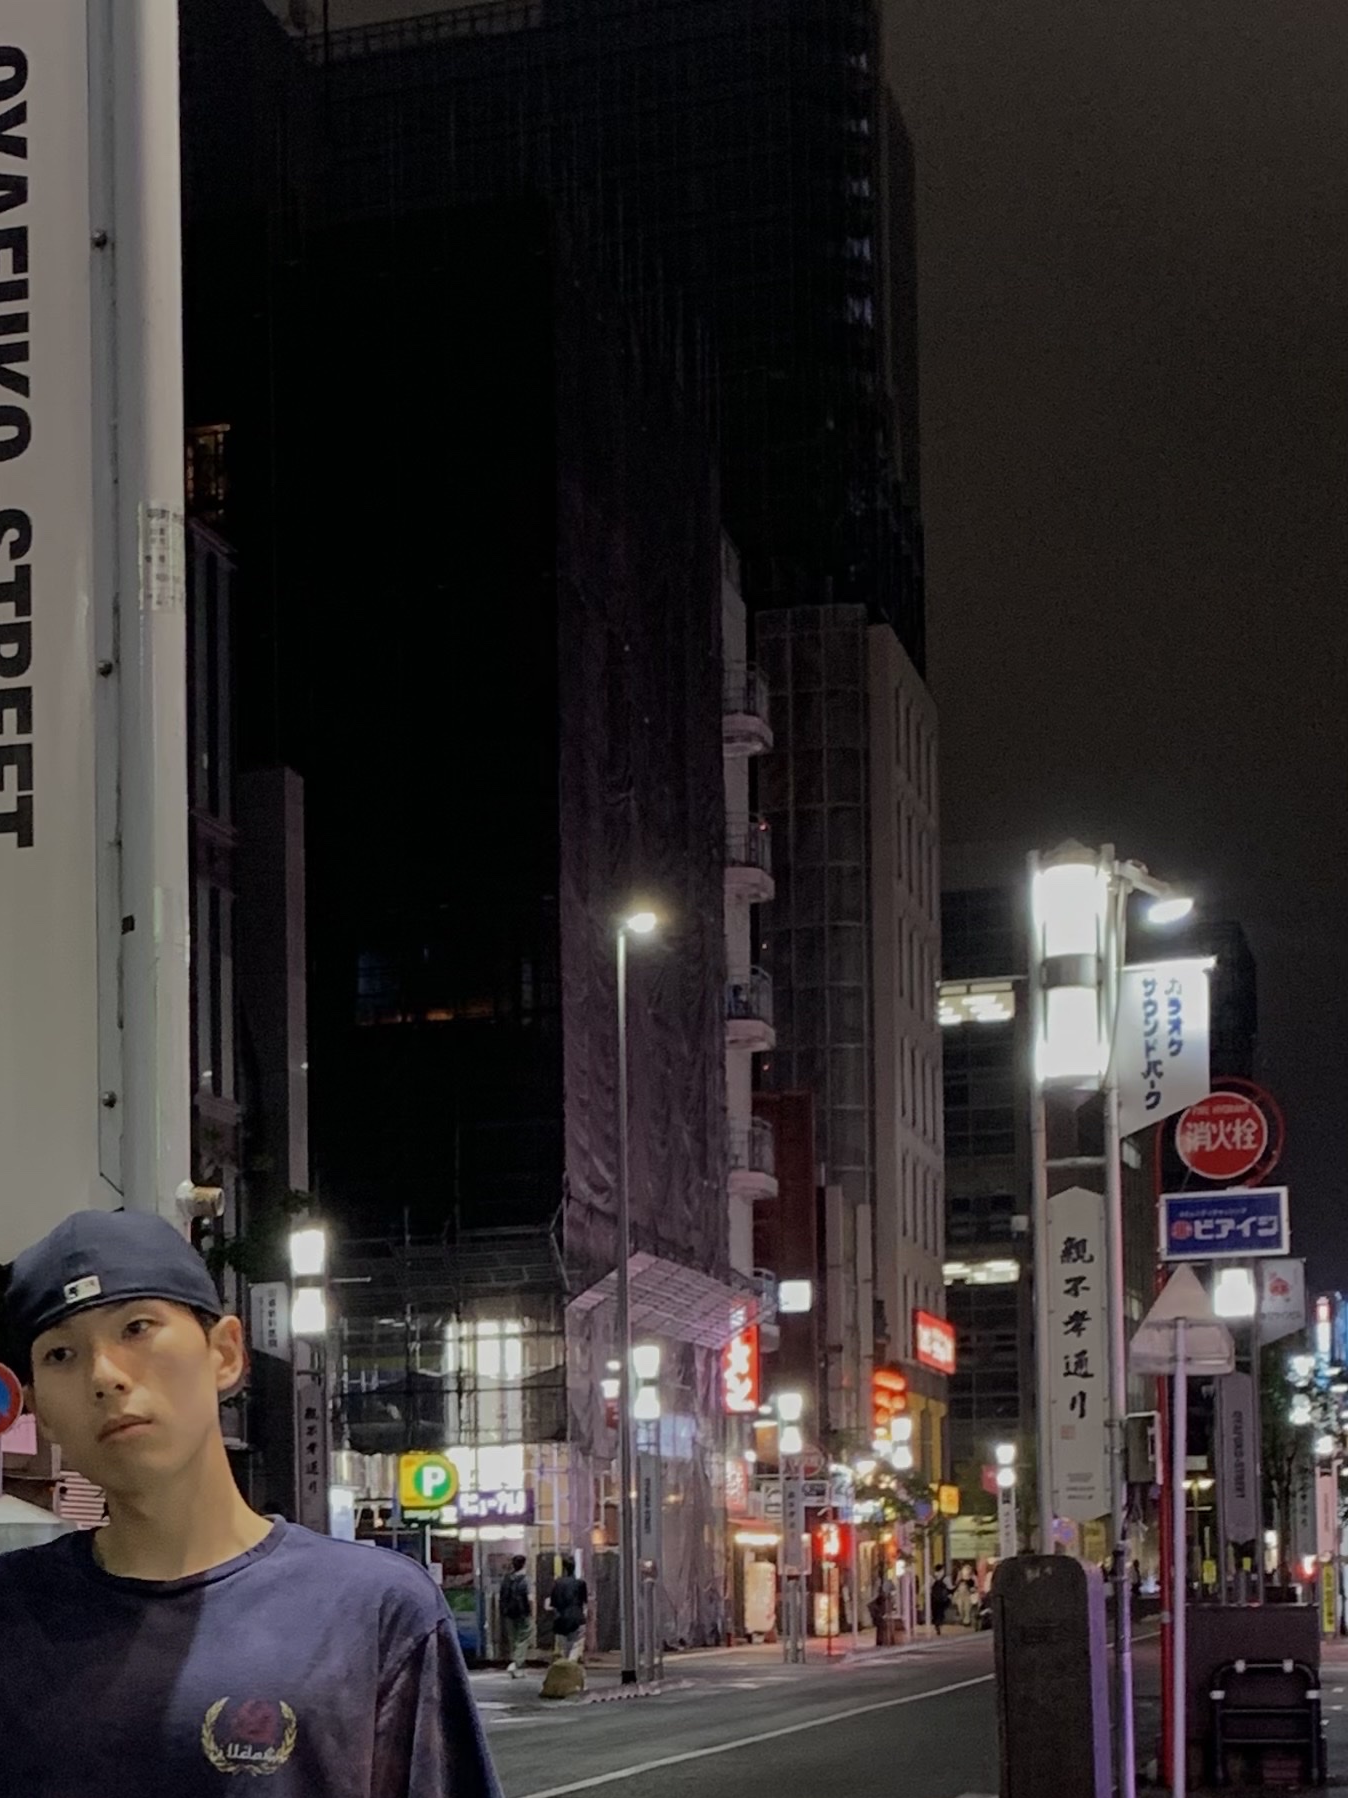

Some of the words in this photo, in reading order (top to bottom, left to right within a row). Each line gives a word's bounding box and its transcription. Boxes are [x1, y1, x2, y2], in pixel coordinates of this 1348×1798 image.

[1186, 1117, 1258, 1152] 消火栓
[1060, 1237, 1095, 1419] 親不孝通り
[422, 1466, 446, 1497] P
